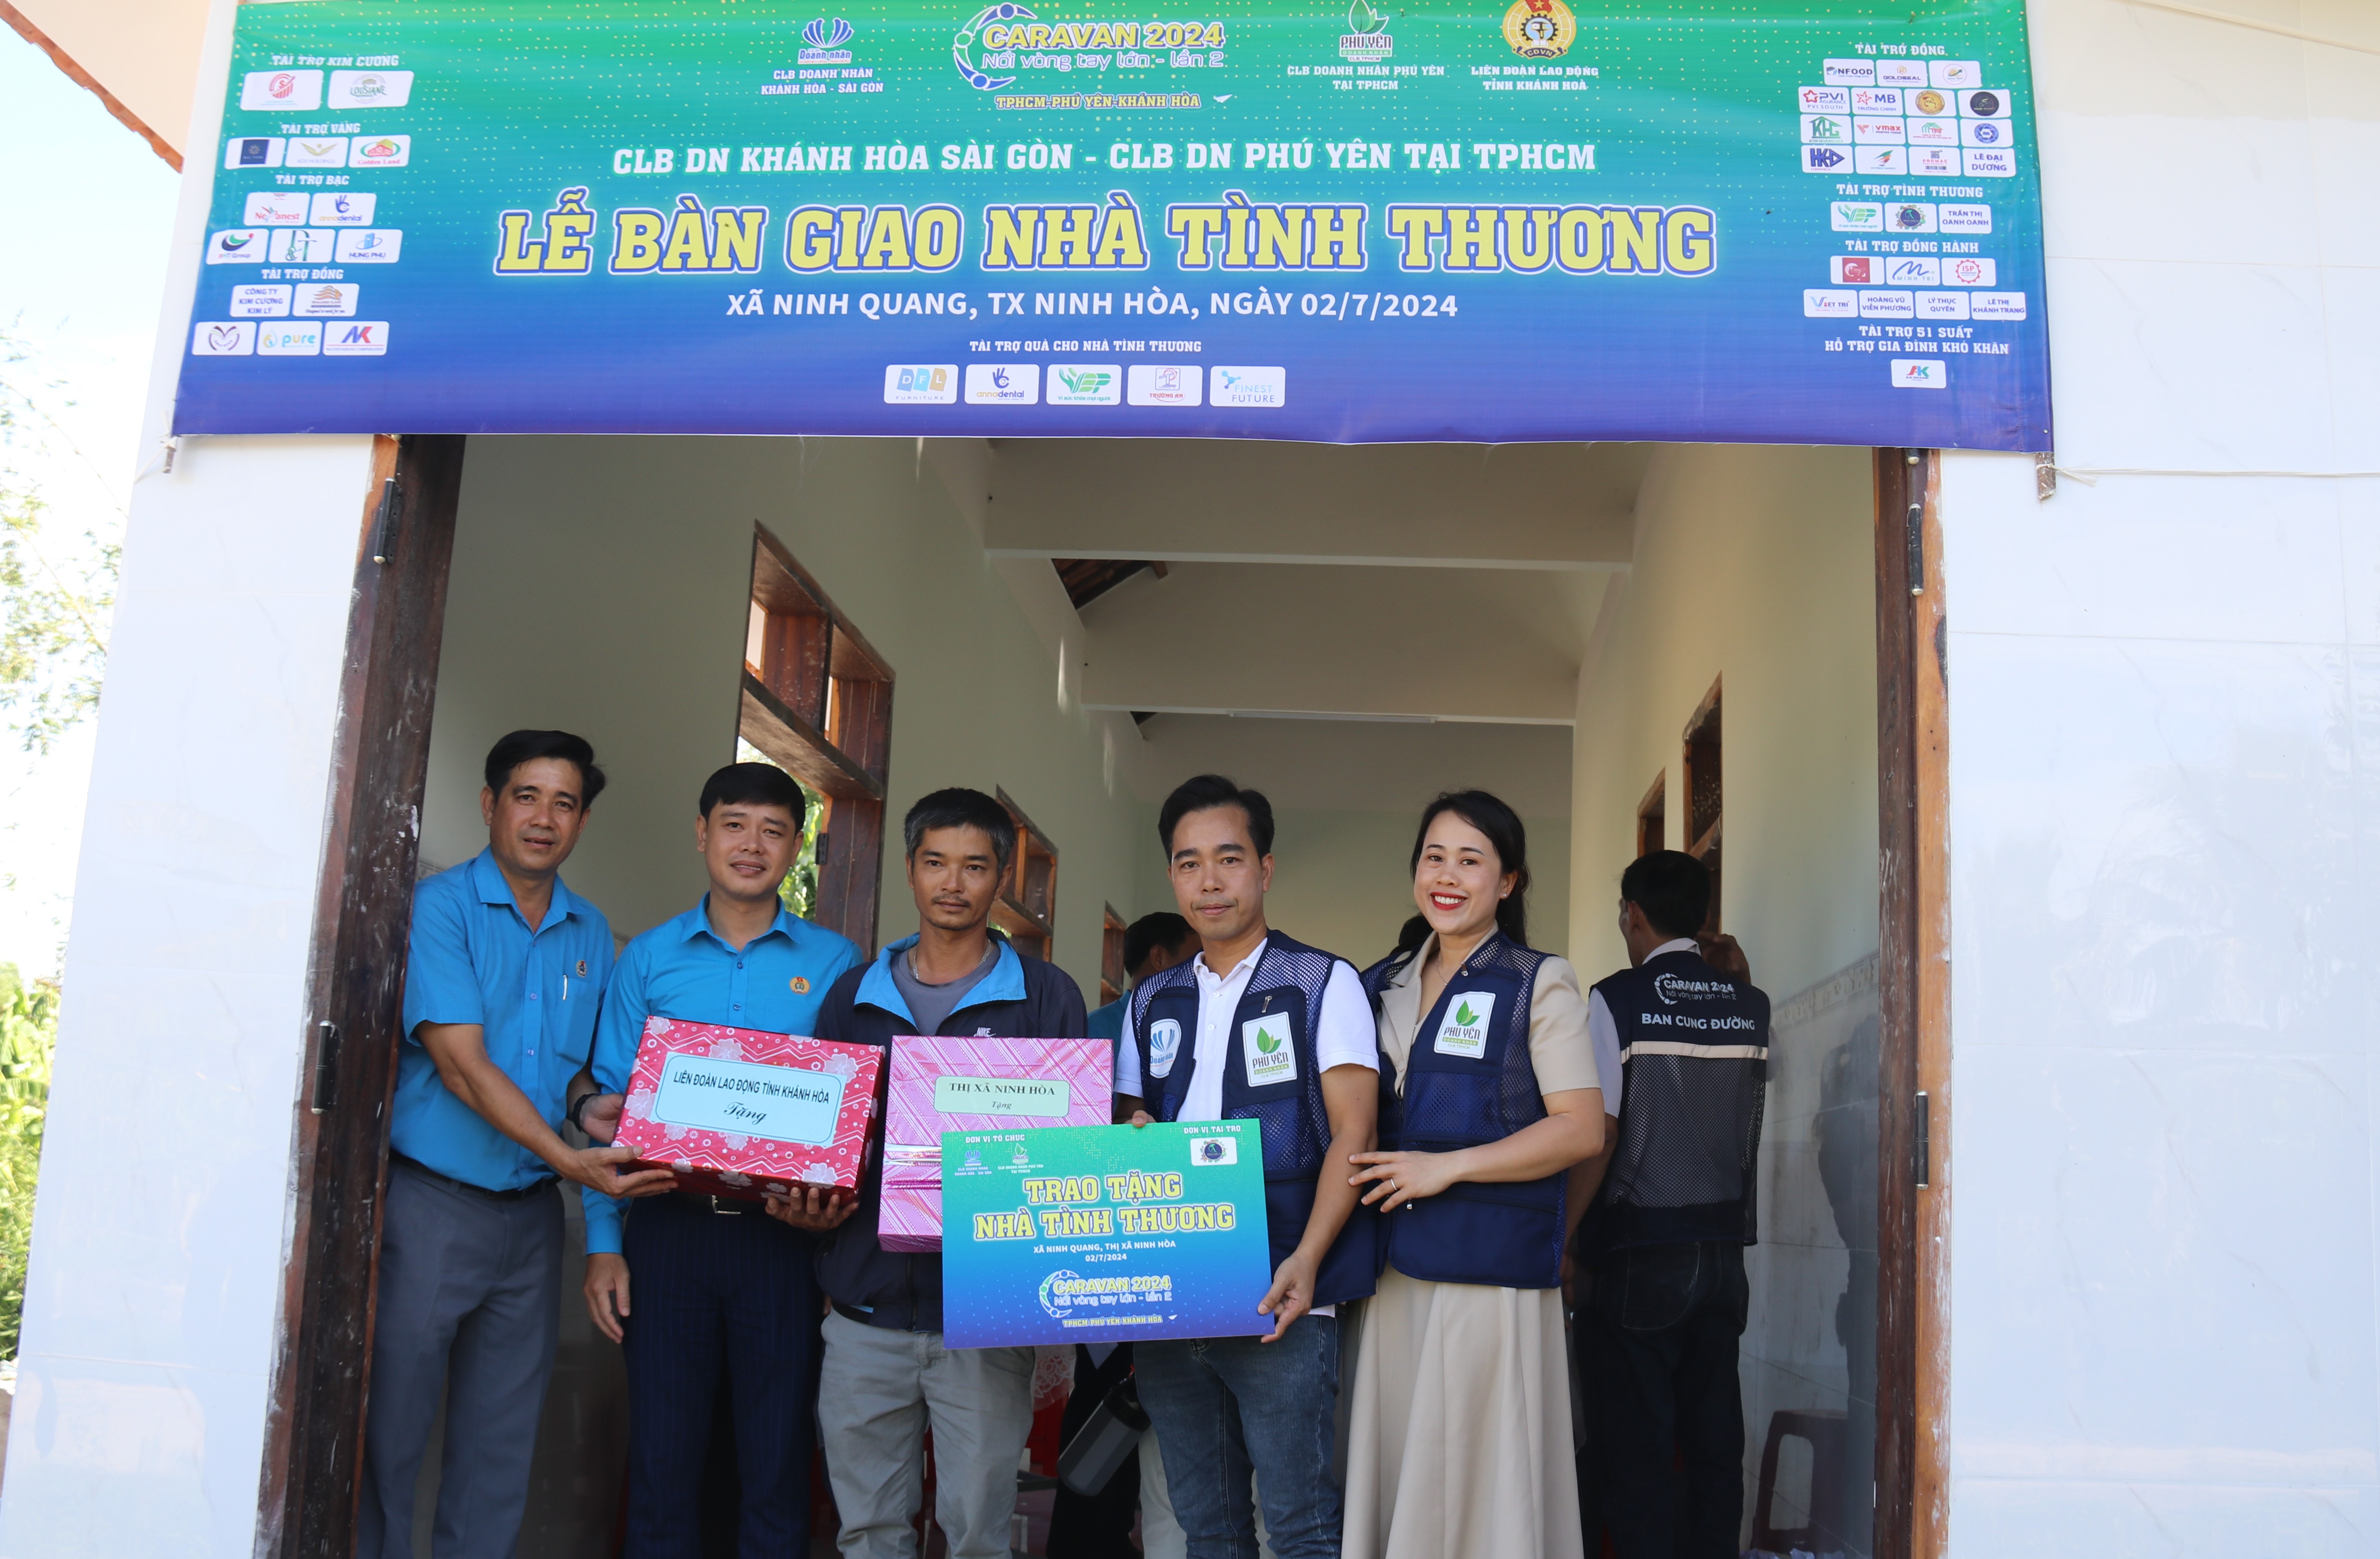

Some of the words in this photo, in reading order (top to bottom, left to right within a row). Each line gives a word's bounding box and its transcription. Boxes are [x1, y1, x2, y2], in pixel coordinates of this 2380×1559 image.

[985, 23, 1139, 49] CARAVAN
[1145, 23, 1225, 47] 2024
[1855, 43, 1877, 54] TÀI
[1881, 45, 1907, 57] TRỢ
[1911, 43, 1945, 55] ĐỒNG
[272, 53, 294, 65] TÀI
[297, 56, 326, 67] TRỢ
[327, 57, 353, 66] KIM
[982, 51, 1015, 69] Nối
[1022, 52, 1071, 70] vòng
[1077, 53, 1112, 70] tay
[1117, 52, 1150, 67] lớn
[1170, 50, 1203, 67] lần
[1209, 51, 1224, 66] 2
[773, 70, 796, 80] CLB
[799, 69, 838, 79] DOANH
[841, 67, 873, 78] NHÂN
[1287, 66, 1310, 75] CLB
[1314, 66, 1353, 75] DOANH
[1357, 65, 1389, 75] NHÂN
[1394, 64, 1418, 75] PHÚ
[1421, 65, 1444, 75] YÊN
[1471, 65, 1500, 75] LIÊN
[1503, 64, 1536, 75] ĐOÀN
[1539, 67, 1563, 75] LAO
[1566, 66, 1598, 77] ĐỘNG
[761, 83, 800, 95] KHÁNH
[803, 81, 826, 94] HÒA
[838, 81, 857, 93] SÀI
[860, 81, 884, 93] GÒN
[1333, 80, 1352, 91] TẠI
[1356, 80, 1398, 90] TPHCM
[1483, 78, 1513, 90] TỈNH
[1516, 79, 1559, 90] KHÁNH
[1562, 79, 1587, 90] HOÀ
[1171, 93, 1200, 107] HÒA
[1875, 94, 1896, 103] MB
[281, 123, 301, 134] TÀI
[304, 124, 329, 136] TRỢ
[330, 122, 361, 133] VÀNG
[614, 149, 674, 174] CLB
[685, 148, 727, 173] DN
[741, 140, 852, 171] KHÁNH
[865, 139, 929, 170] HÒA
[940, 140, 995, 170] SÀI
[1007, 140, 1073, 169] GÒN
[1110, 143, 1173, 169] CLB
[1186, 143, 1232, 168] DN
[1245, 139, 1313, 169] PHÚ
[1326, 139, 1391, 169] YÊN
[1404, 143, 1464, 174] TẠI
[1474, 144, 1595, 170] TPHCM
[275, 173, 296, 185] TÀI
[299, 175, 325, 186] TRỢ
[326, 175, 350, 186] BẠC
[1837, 182, 1858, 195] TÀI
[1863, 184, 1890, 197] TRỢ
[1894, 183, 1925, 196] TÌNH
[1930, 186, 1983, 197] THƯƠNG
[497, 188, 595, 273] LỄ
[611, 196, 766, 273] BÀN
[786, 206, 962, 273] GIAO
[983, 190, 1149, 271] NHÀ
[1167, 190, 1365, 271] TÌNH
[1388, 205, 1715, 276] THƯƠNG
[1845, 238, 1867, 251] TÀI
[1872, 240, 1899, 253] TRỢ
[1903, 238, 1937, 252] ĐỒNG
[1942, 240, 1979, 253] HÀNH
[261, 267, 282, 279] TÀI
[284, 269, 310, 281] TRỢ
[311, 266, 344, 279] ĐỒNG
[726, 290, 765, 316] XÃ
[773, 293, 848, 316] NINH
[859, 293, 977, 321] QUANG,
[988, 293, 1025, 315] TX
[1035, 293, 1111, 315] NINH
[1123, 286, 1200, 320] HÒA,
[1211, 286, 1292, 315] NGÀY
[1301, 293, 1458, 320] 02/7/2024
[1859, 324, 1881, 336] TÀI
[1886, 326, 1913, 339] TRỢ
[1917, 327, 1932, 337] 51
[1938, 325, 1973, 338] SUẤT
[970, 339, 991, 351] TÀI
[995, 341, 1022, 353] TRỢ
[1024, 339, 1049, 351] QUÀ
[1053, 341, 1078, 351] CHO
[1083, 339, 1109, 351] NHÀ
[1113, 339, 1145, 351] TÌNH
[1149, 341, 1202, 352] THƯƠNG
[1825, 336, 1843, 351] HỖ
[1847, 340, 1874, 353] TRỢ
[1879, 341, 1901, 352] GIA
[1905, 339, 1937, 352] ĐÌNH
[1942, 340, 1968, 353] KHÓ
[1973, 342, 2008, 354] KHĂN
[1664, 980, 1710, 992] CARAVAN
[1642, 1013, 1672, 1025] BAN
[1676, 1016, 1707, 1029] CUNG
[1711, 1015, 1755, 1030] ĐƯỜNG
[976, 1027, 991, 1037] NIKE
[1463, 1027, 1480, 1040] YÊN
[1271, 1051, 1288, 1064] YÊN
[674, 1070, 693, 1084] LIÊN
[694, 1073, 717, 1087] ĐOÀN
[718, 1077, 736, 1090] LAO
[736, 1079, 759, 1094] ĐỘNG
[762, 1080, 781, 1096] TỈNH
[781, 1085, 810, 1101] KHÁNH
[811, 1088, 829, 1104] HÒA
[949, 1083, 971, 1093] THỊ
[974, 1082, 991, 1092] XÃ
[995, 1085, 1025, 1094] NINH
[1029, 1083, 1055, 1095] HÒA
[992, 1101, 1012, 1110] Tặng
[724, 1102, 768, 1125] Tặng
[1025, 1177, 1099, 1203] TRAO
[1107, 1171, 1181, 1203] TẶNG
[975, 1208, 1035, 1240] NHÀ
[1042, 1207, 1111, 1236] TÌNH
[1119, 1204, 1234, 1232] THƯƠNG
[1033, 1244, 1045, 1253] XÃ
[1070, 1244, 1103, 1253] QUANG,
[1105, 1243, 1119, 1251] THỊ
[1122, 1241, 1132, 1250] XÃ
[1158, 1239, 1176, 1248] HÒA
[1085, 1253, 1127, 1262] 02/7/2024
[1054, 1279, 1130, 1294] CARAVAN
[1132, 1276, 1172, 1292] 2024
[1100, 1295, 1118, 1305] tay
